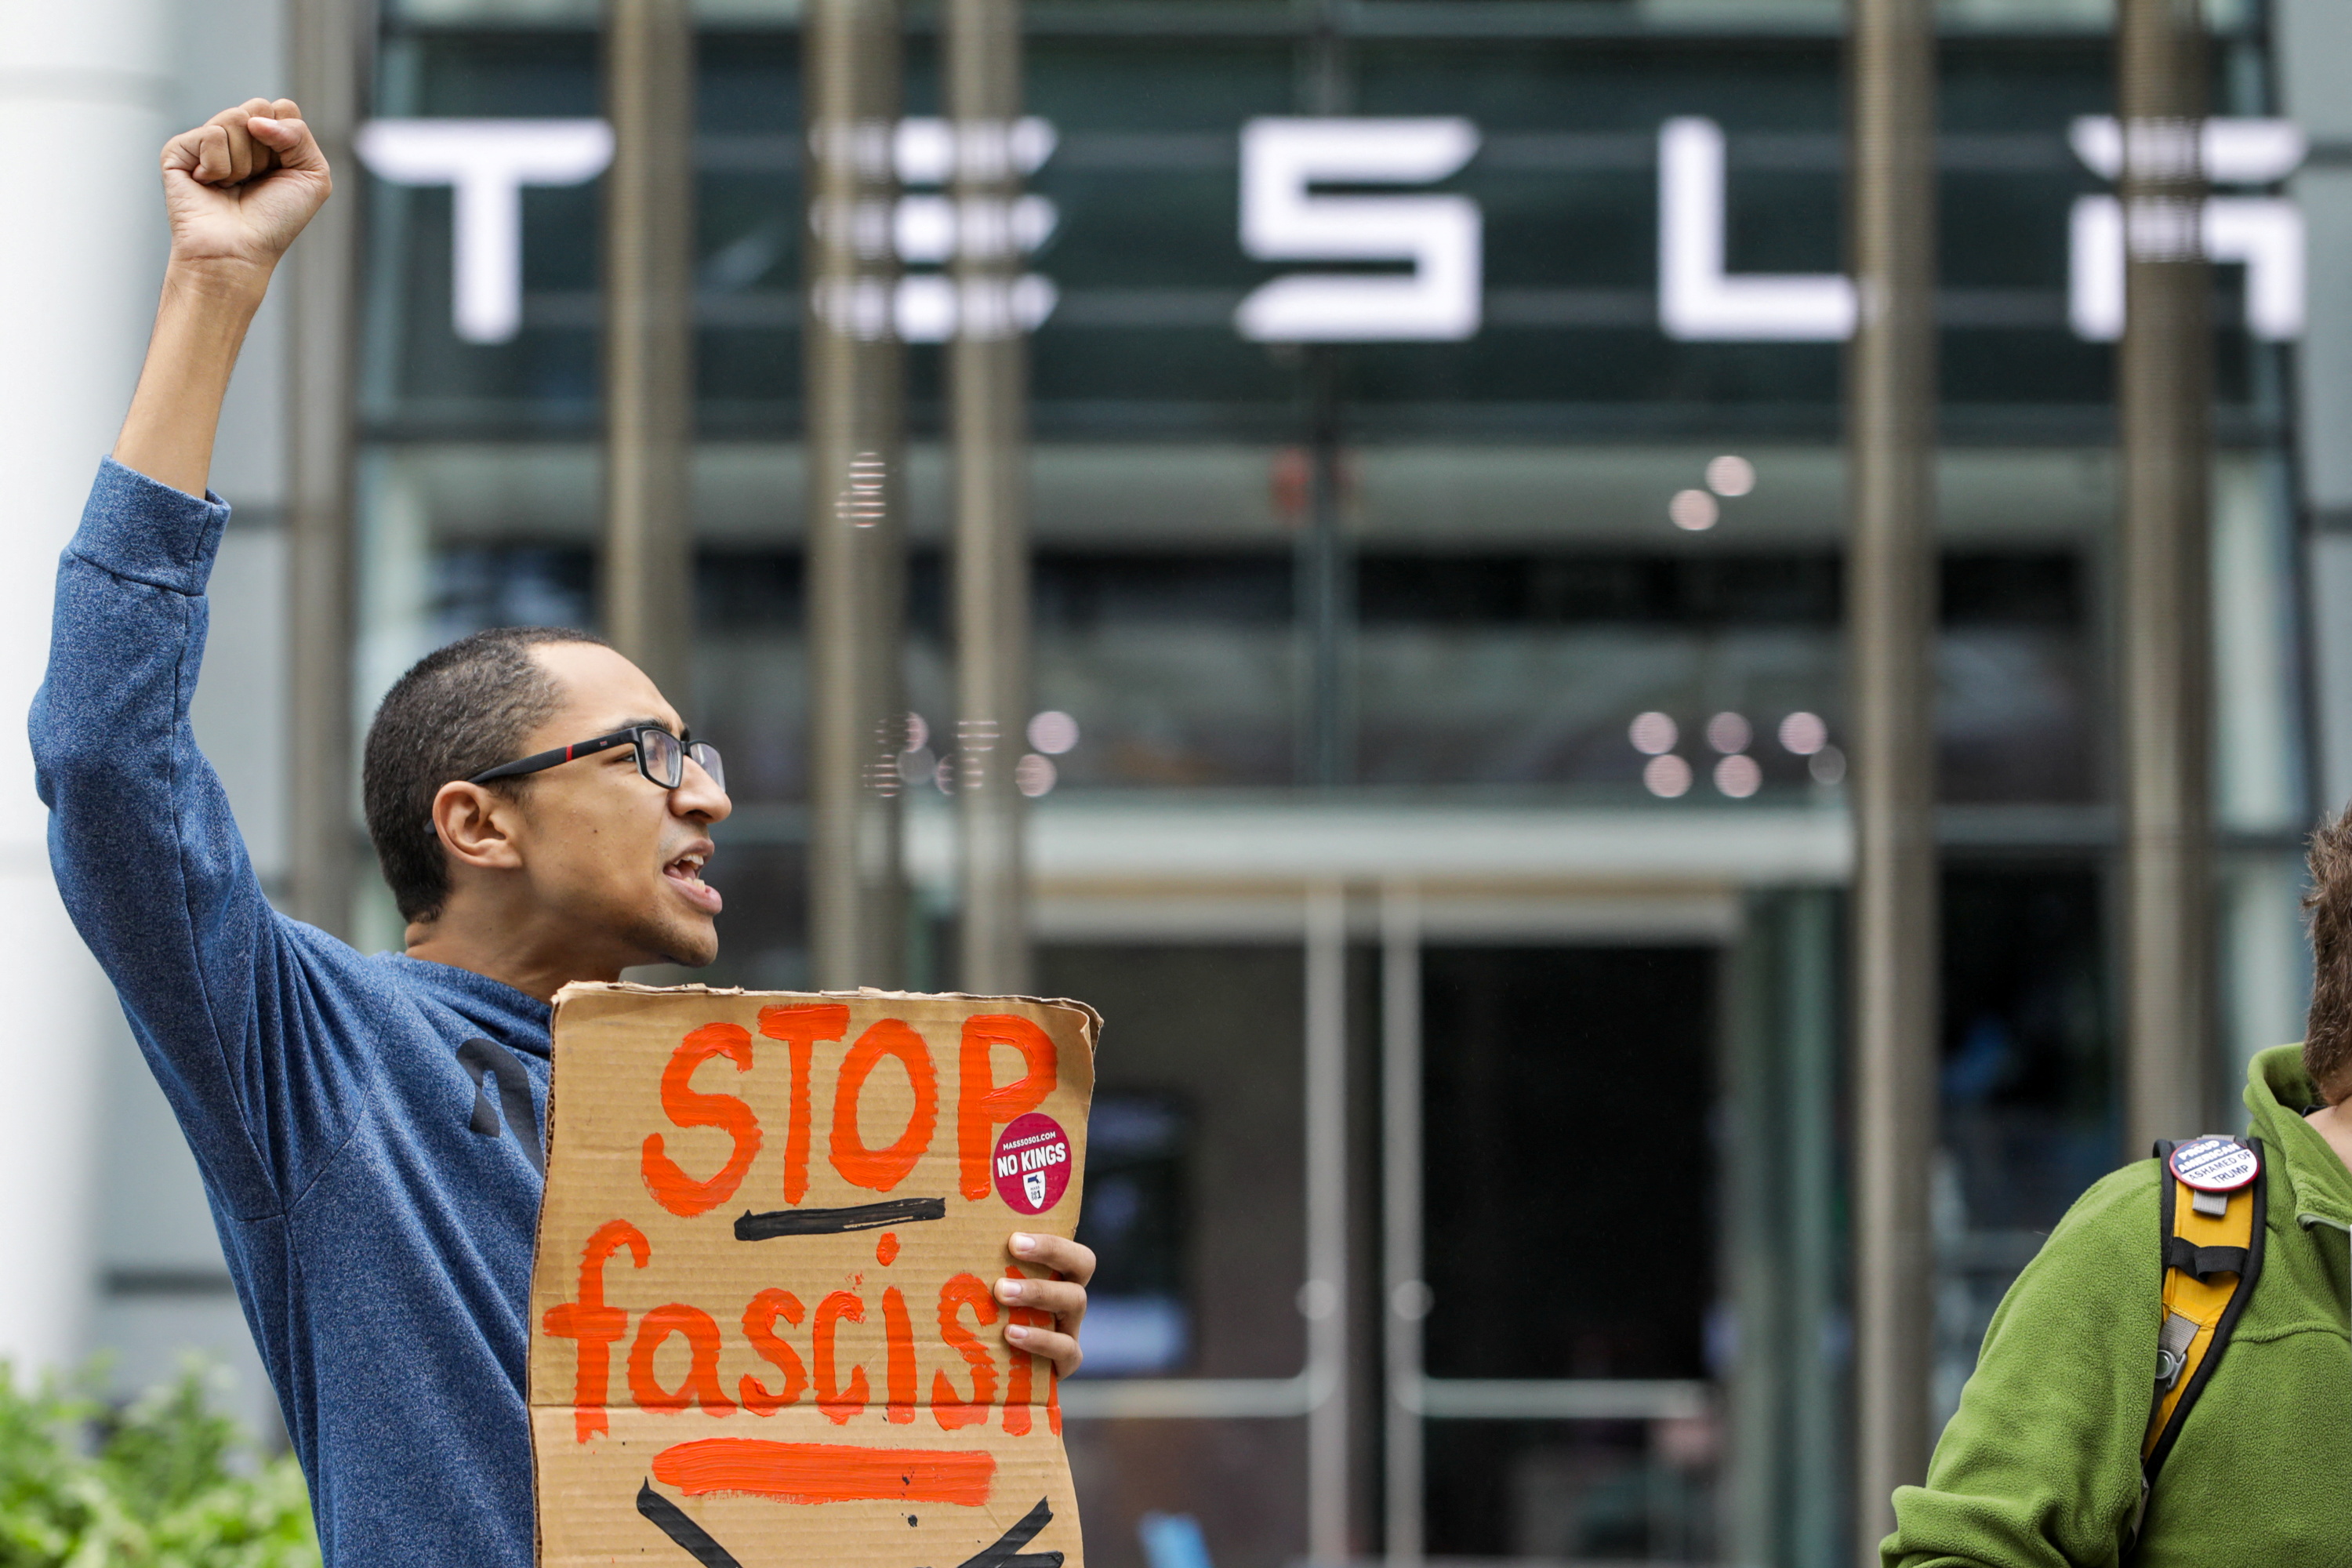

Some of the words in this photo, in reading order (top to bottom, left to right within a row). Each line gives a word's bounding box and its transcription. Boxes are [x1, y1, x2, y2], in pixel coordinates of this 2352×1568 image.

[354, 116, 2308, 344] TESLA
[641, 1004, 1057, 1218] STOP
[1003, 1131, 1056, 1150] MASS50501.COM
[2178, 1140, 2220, 1160] PROUD
[996, 1154, 1018, 1178] NO
[1021, 1142, 1066, 1172] KINGS
[2178, 1143, 2241, 1173] AMERICAN
[2189, 1157, 2238, 1181] ASHAMED
[2238, 1151, 2252, 1160] OF
[2212, 1164, 2249, 1183] TRUMP
